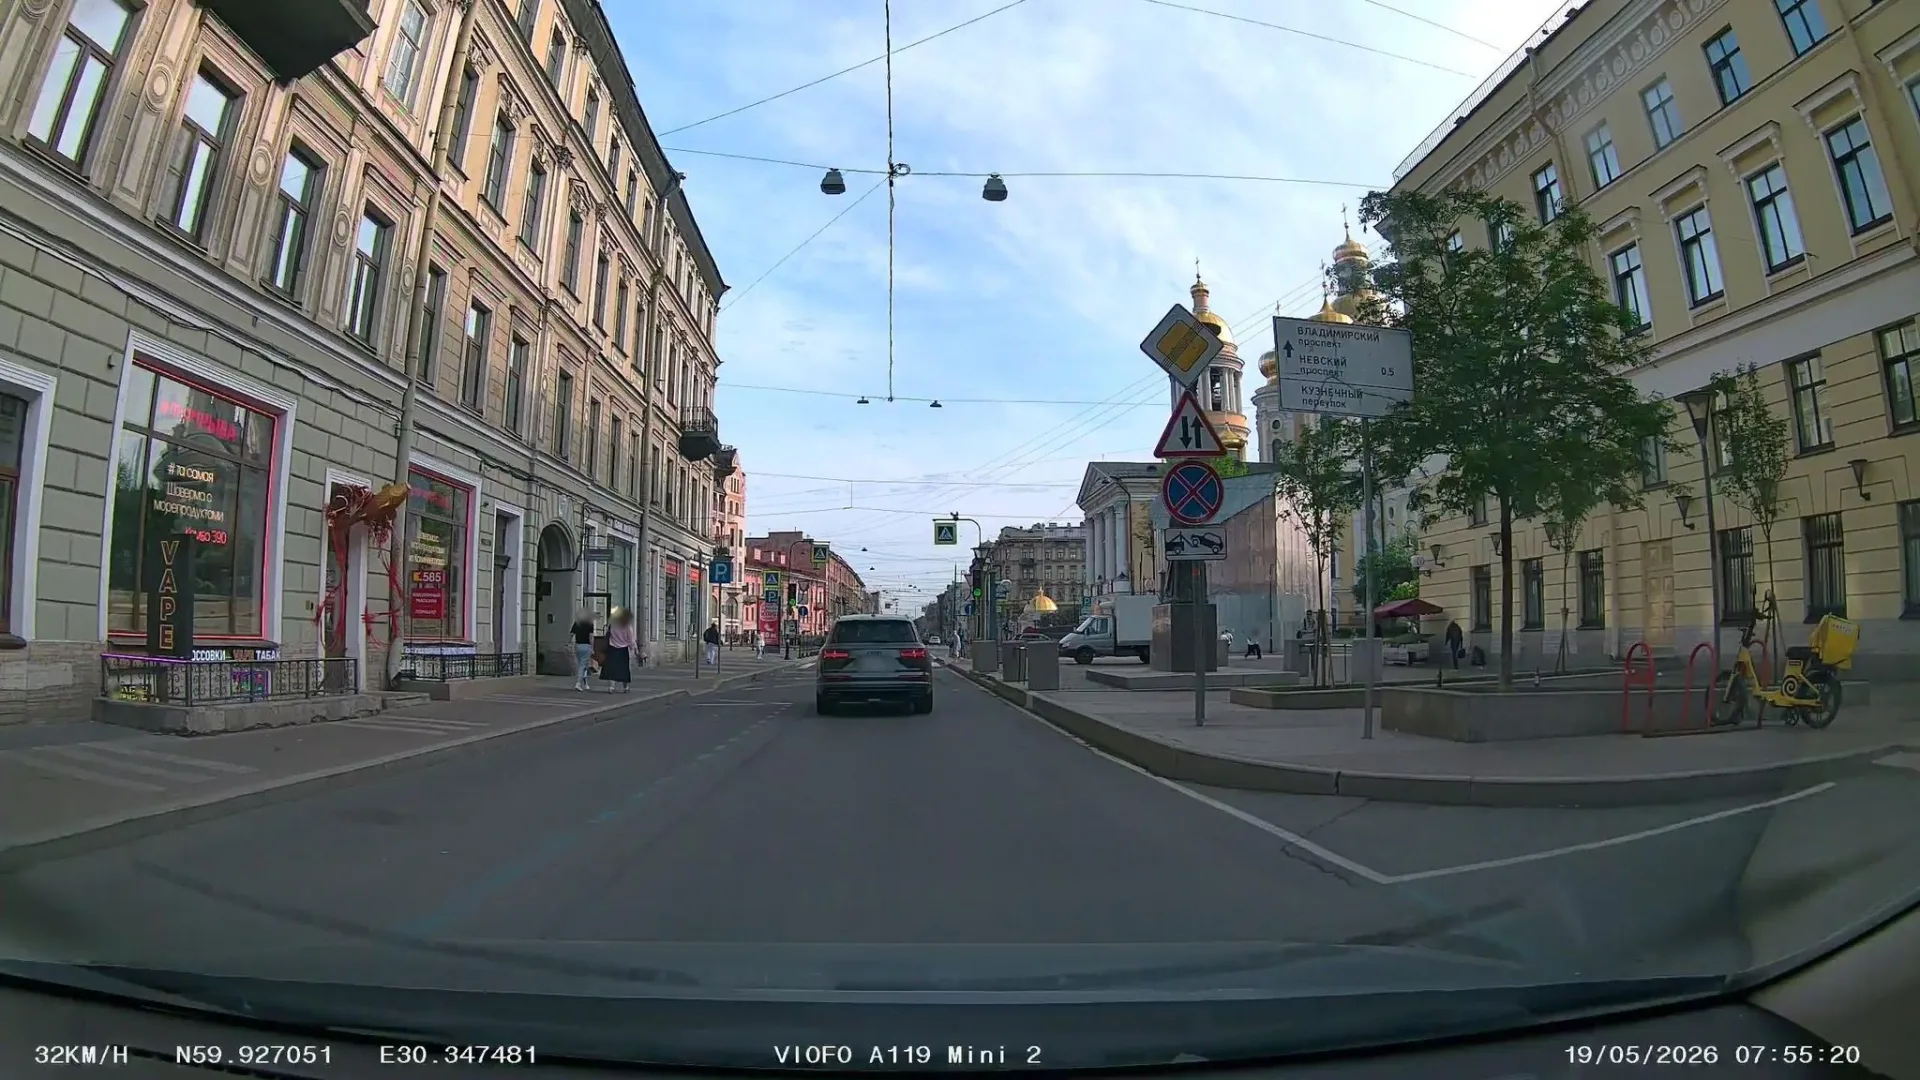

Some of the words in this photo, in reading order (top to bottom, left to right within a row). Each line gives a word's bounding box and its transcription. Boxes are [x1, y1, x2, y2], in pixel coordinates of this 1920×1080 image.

[1297, 326, 1380, 342] ВЛАДИМИРСКИЙ
[1298, 338, 1341, 348] проспект
[1299, 354, 1347, 367] НЕВСКИЙ
[1300, 367, 1344, 378] проспект
[1301, 385, 1363, 399] КУЗНЕЧНЫЙ
[1302, 398, 1347, 409] переулок
[187, 467, 214, 483] самая
[166, 482, 206, 502] Шаверма
[153, 500, 224, 523] морепродуктами
[212, 529, 227, 545] 390
[158, 540, 180, 650] VAPE
